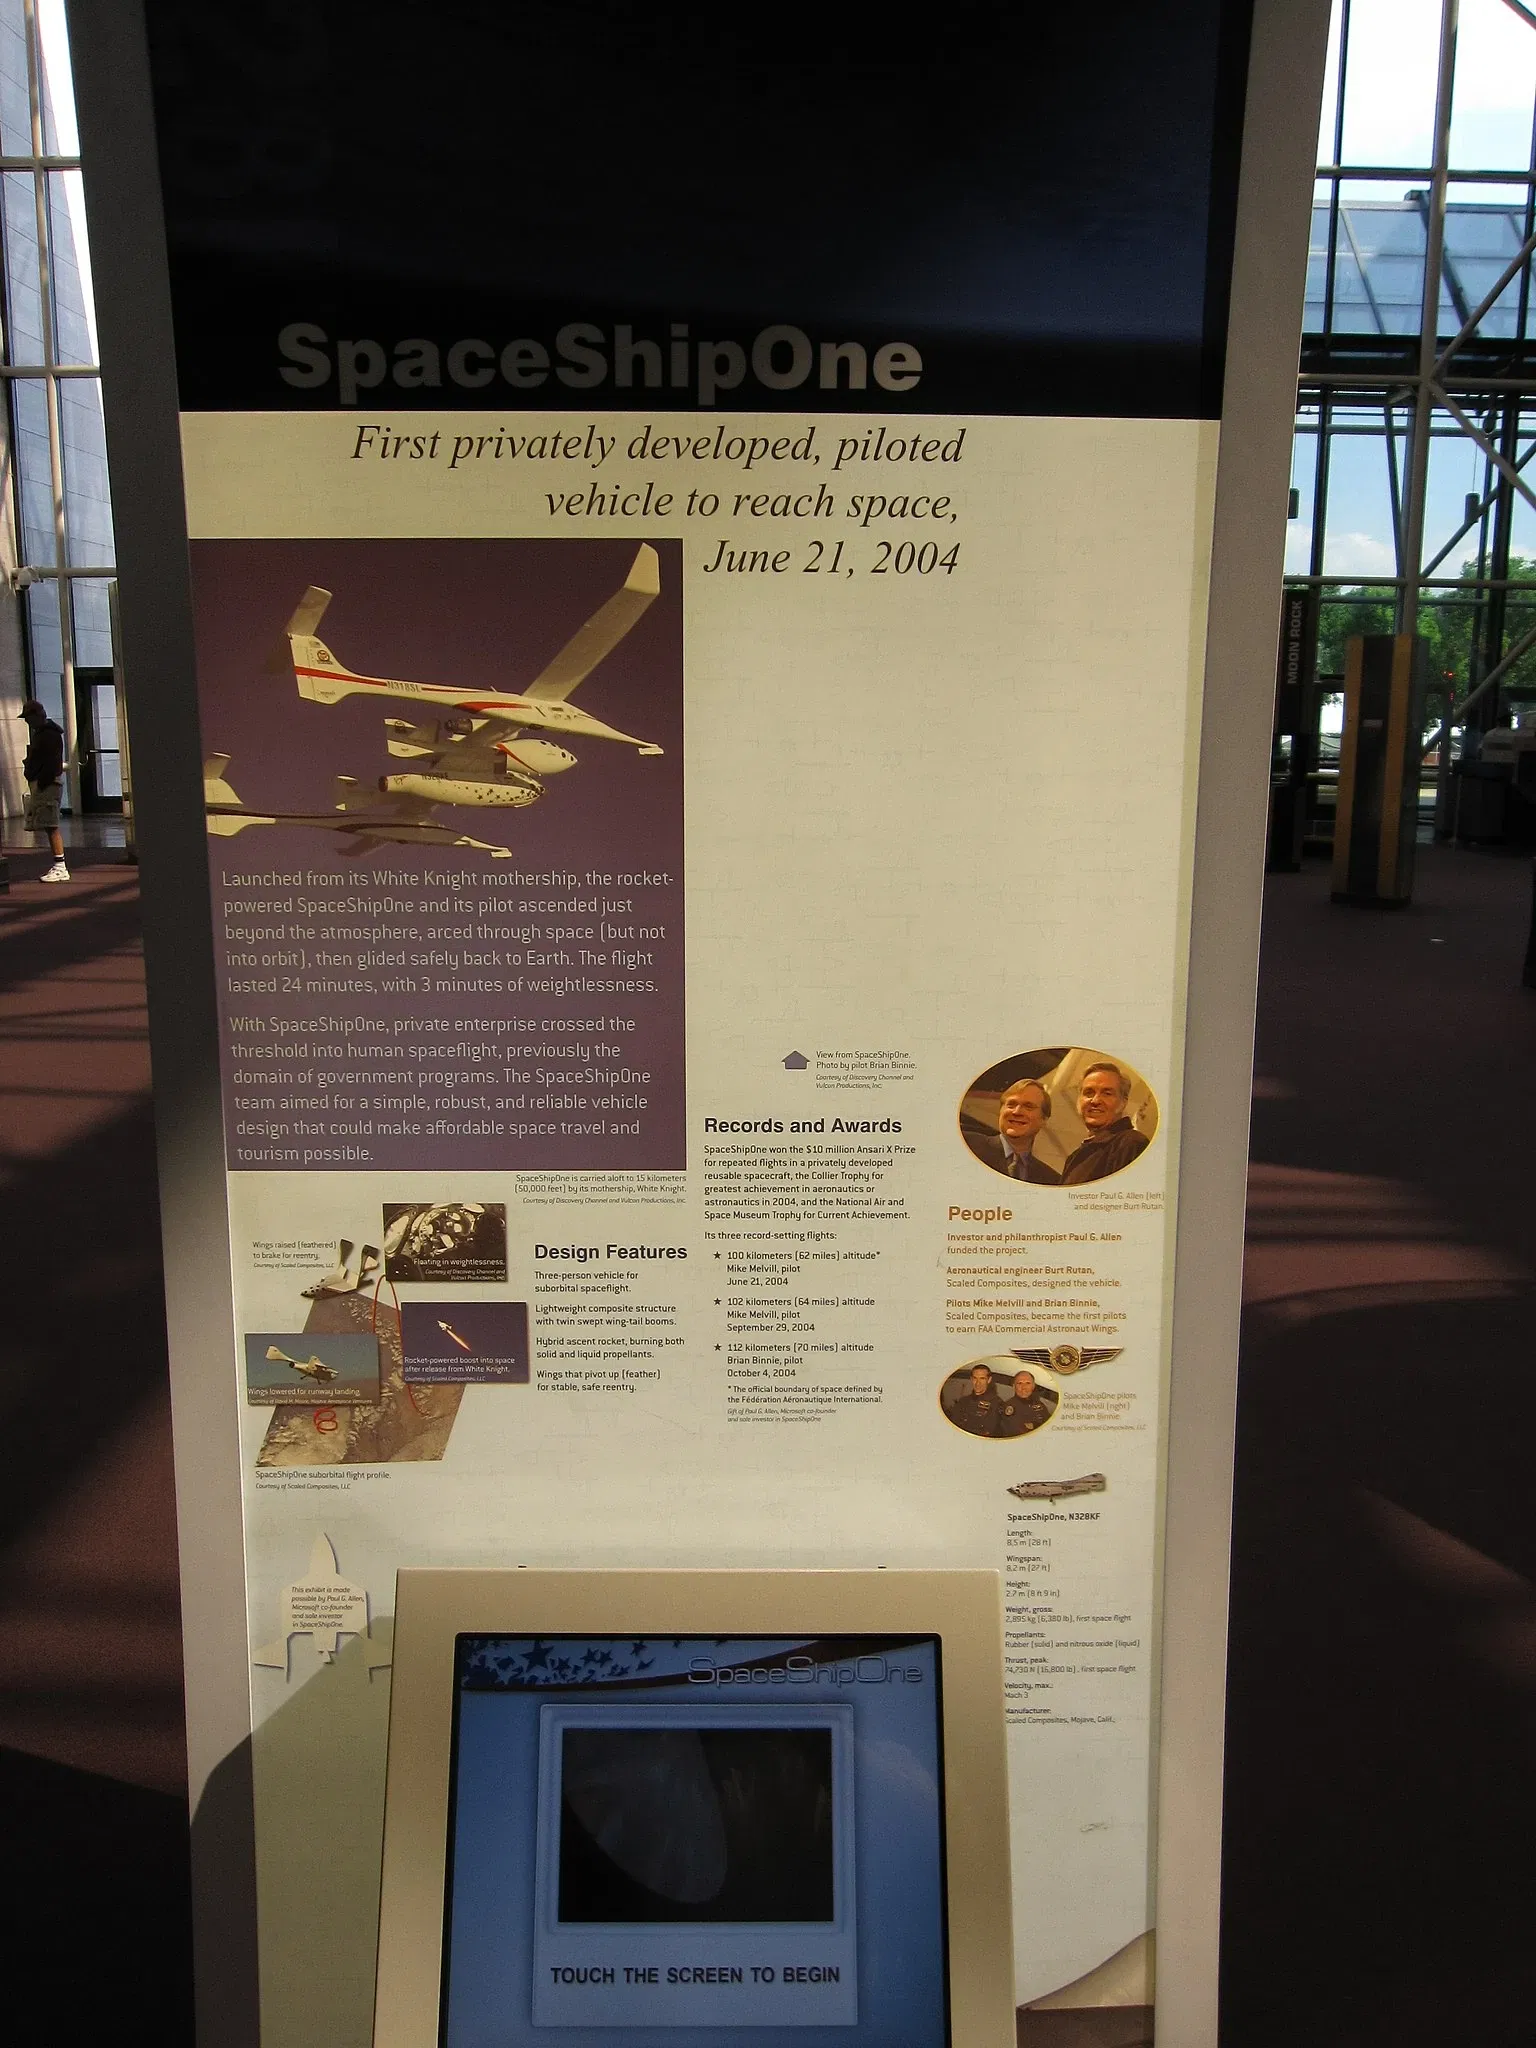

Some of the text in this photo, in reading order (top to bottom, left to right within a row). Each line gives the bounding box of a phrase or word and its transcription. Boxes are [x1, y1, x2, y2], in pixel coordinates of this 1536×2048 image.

[279, 324, 923, 405] SpaceShipOne
[350, 425, 966, 470] First privately developed, piloted
[545, 482, 957, 527] vehicle to reach space,
[703, 540, 960, 579] June 21, 2004
[1287, 600, 1303, 684] MOON ROCK
[223, 870, 674, 890] Launched from its White Knight mothership, the rocket-
[224, 897, 632, 918] powered SpaceShipOne and its pilot ascended just
[225, 924, 284, 944] beyond
[289, 924, 315, 939] the
[321, 924, 422, 944] atmosphere,
[427, 924, 472, 939] arced
[477, 924, 541, 944] through
[546, 928, 594, 944] space
[640, 926, 666, 939] not
[226, 951, 257, 966] into
[316, 951, 352, 966] then
[358, 950, 405, 970] glided
[410, 950, 458, 970] safely
[464, 950, 502, 966] back
[506, 953, 522, 966] to
[527, 950, 574, 966] Earth.
[578, 950, 606, 965] The
[611, 950, 653, 970] flight
[229, 976, 658, 996] lasted 24 minutes, with 3 minutes of weightlessness.
[230, 1016, 636, 1036] With SpaceShipOne, private enterprise crossed the
[855, 1051, 910, 1060] SpaceShipOne.
[705, 1118, 902, 1133] Records and Awards
[704, 1145, 767, 1156] SpaceShipOne
[789, 1145, 804, 1154] the
[806, 1145, 823, 1154] $10
[825, 1145, 855, 1154] million
[857, 1145, 884, 1153] Ansari
[887, 1145, 892, 1153] X
[895, 1145, 916, 1154] Prize
[705, 1211, 910, 1222] Space Museum Trophy for Current Achievement.
[949, 1206, 1012, 1224] People
[948, 1233, 1122, 1244] Investor and philanthropist Paul G. Allen
[252, 1242, 274, 1250] Wings
[535, 1245, 688, 1262] Design Features
[728, 1251, 744, 1260] 100
[746, 1252, 792, 1260] kilometers
[414, 1258, 442, 1267] Floating
[450, 1259, 506, 1268] weightlessness.
[749, 1264, 779, 1273] Melvill,
[781, 1265, 800, 1274] pilot
[535, 1271, 592, 1282] Three-person
[626, 1271, 638, 1279] for
[947, 1279, 975, 1288] Scaled
[977, 1279, 1030, 1290] Composites,
[1032, 1280, 1071, 1290] designed
[1089, 1279, 1122, 1287] vehicle.
[536, 1305, 586, 1314] Lightweight
[588, 1306, 634, 1314] composite
[727, 1323, 815, 1334] September 29, 2004
[728, 1343, 743, 1352] 112
[745, 1344, 791, 1352] kilometers
[841, 1343, 874, 1351] altitude
[486, 1366, 510, 1374] Knight.
[537, 1370, 563, 1380] Wings
[565, 1370, 582, 1378] that
[585, 1371, 606, 1380] pivot
[608, 1372, 619, 1380] up
[255, 1471, 307, 1480] SpaceShipOne
[346, 1471, 365, 1480] flight
[366, 1472, 392, 1480] profile.
[687, 1655, 922, 1687] SpaceShipOne
[550, 1967, 840, 1984] TOUCH THE SCREEN TO BEGIN
